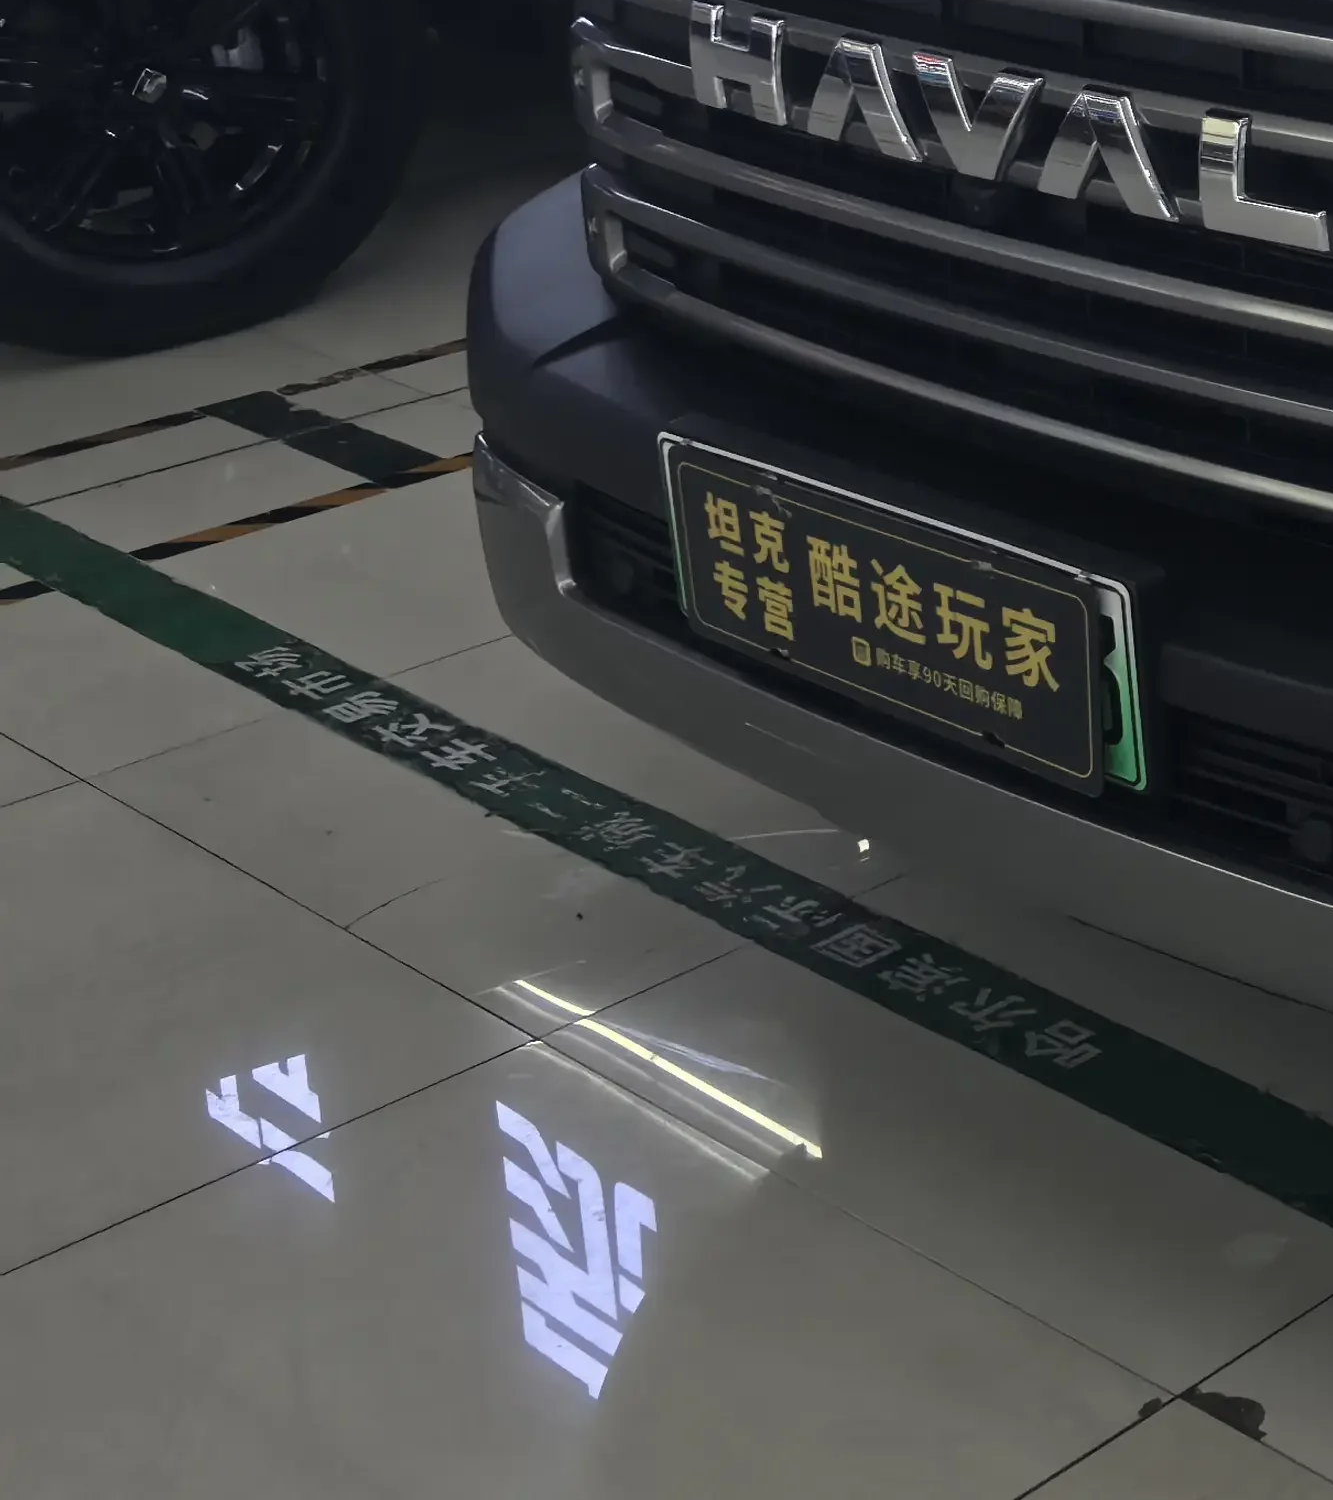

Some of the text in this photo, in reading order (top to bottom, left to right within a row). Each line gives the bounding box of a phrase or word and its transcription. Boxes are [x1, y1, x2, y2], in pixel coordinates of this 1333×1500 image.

[689, 0, 1332, 252] HAVAL
[703, 490, 791, 574] 坦克
[712, 560, 795, 641] 专营
[805, 534, 1061, 693] 酷途玩家
